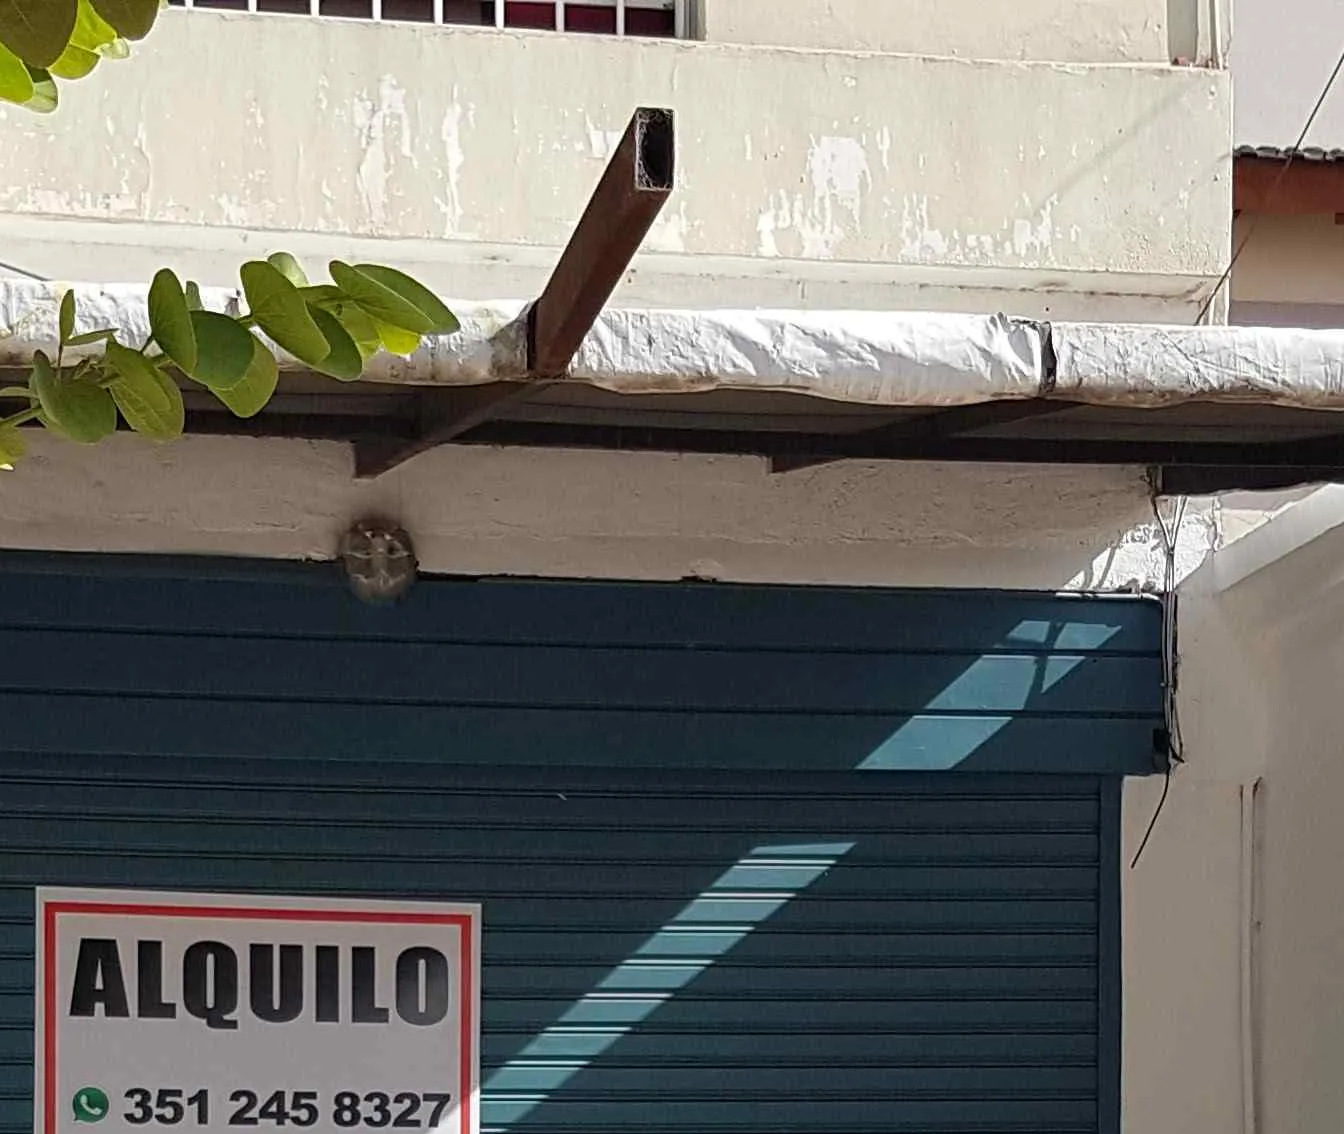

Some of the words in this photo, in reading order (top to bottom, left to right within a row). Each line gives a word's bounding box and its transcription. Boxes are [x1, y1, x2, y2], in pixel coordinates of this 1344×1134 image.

[68, 937, 450, 1030] ALQUILO
[123, 1087, 209, 1126] 351
[228, 1089, 319, 1128] 245
[332, 1090, 451, 1129] 8327
